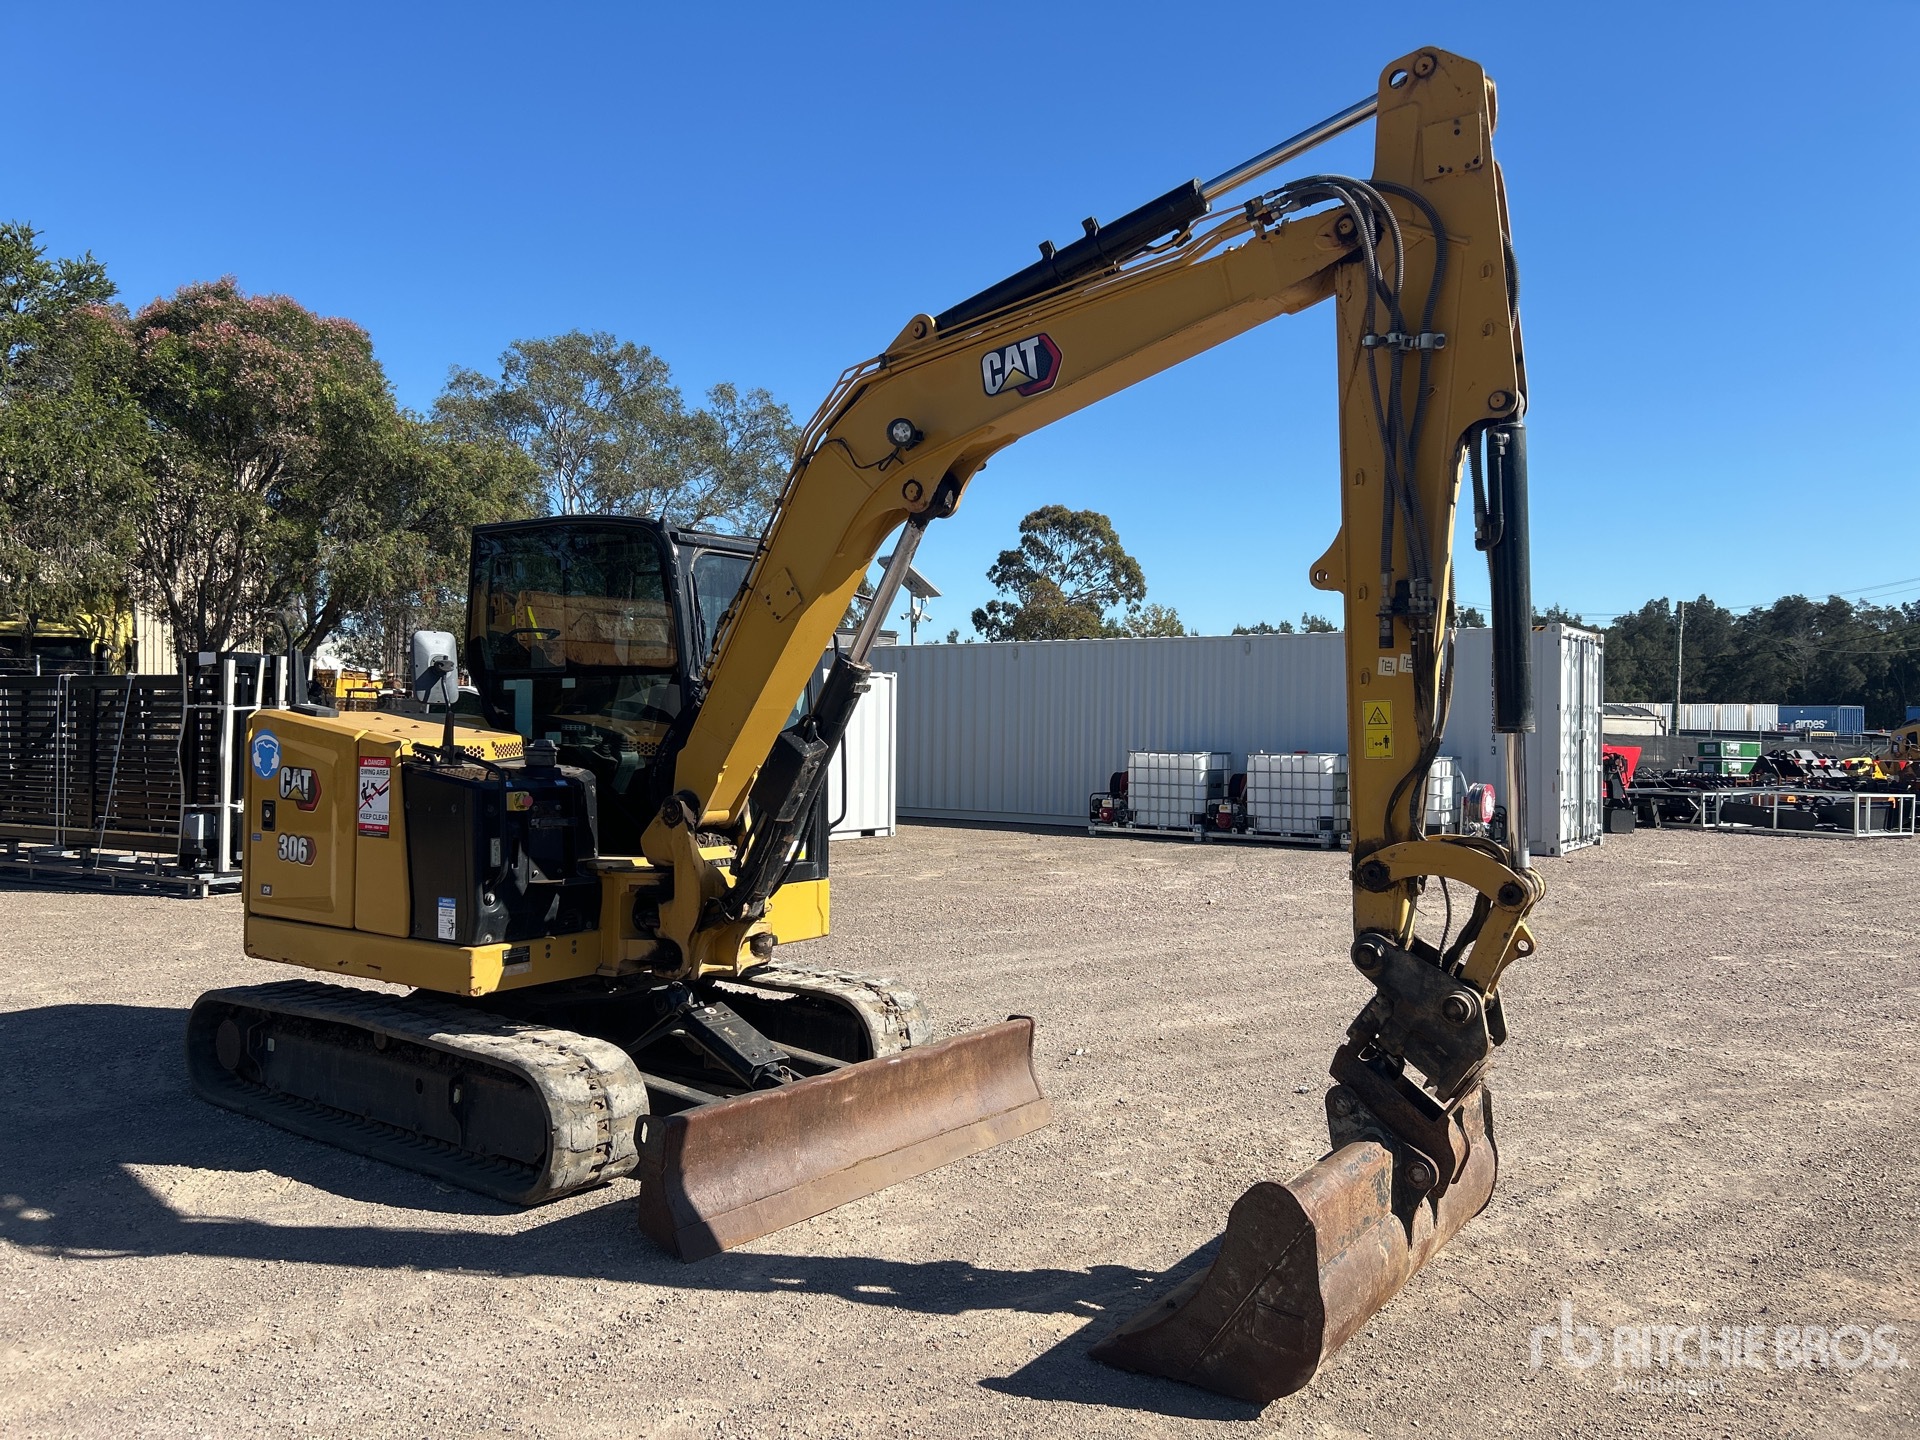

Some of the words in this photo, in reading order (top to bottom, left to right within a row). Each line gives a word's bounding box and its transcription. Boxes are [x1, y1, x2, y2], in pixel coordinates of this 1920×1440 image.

[982, 336, 1039, 395] CAT
[280, 767, 312, 801] CAT
[360, 768, 376, 776] SWING
[278, 834, 308, 863] 306
